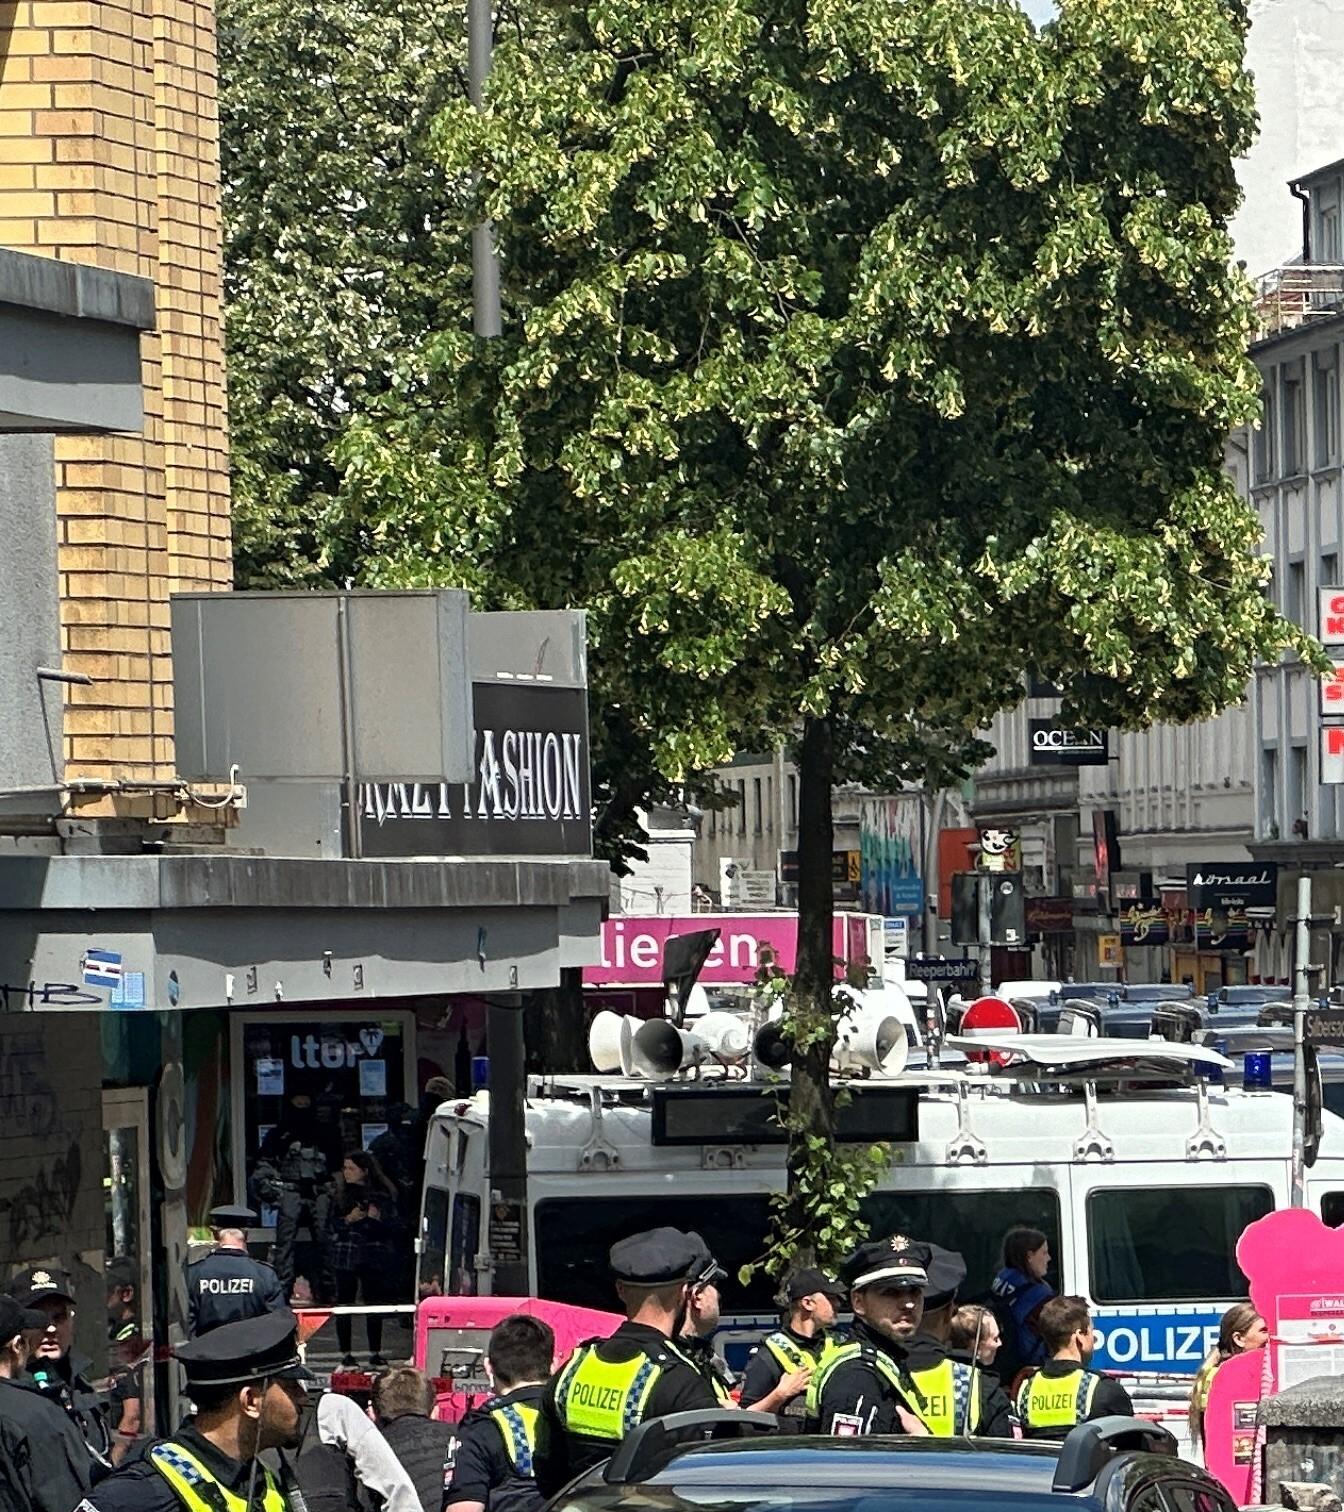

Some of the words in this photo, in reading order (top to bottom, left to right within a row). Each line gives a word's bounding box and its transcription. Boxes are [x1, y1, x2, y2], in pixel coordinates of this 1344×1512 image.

[1033, 730, 1103, 746] OCEN
[910, 962, 976, 978] Reeperbahn
[199, 1278, 254, 1295] POLIZEI
[1092, 1326, 1221, 1363] POLIZE
[571, 1381, 624, 1412] POLIZEI
[1031, 1393, 1073, 1410] POLIZEI
